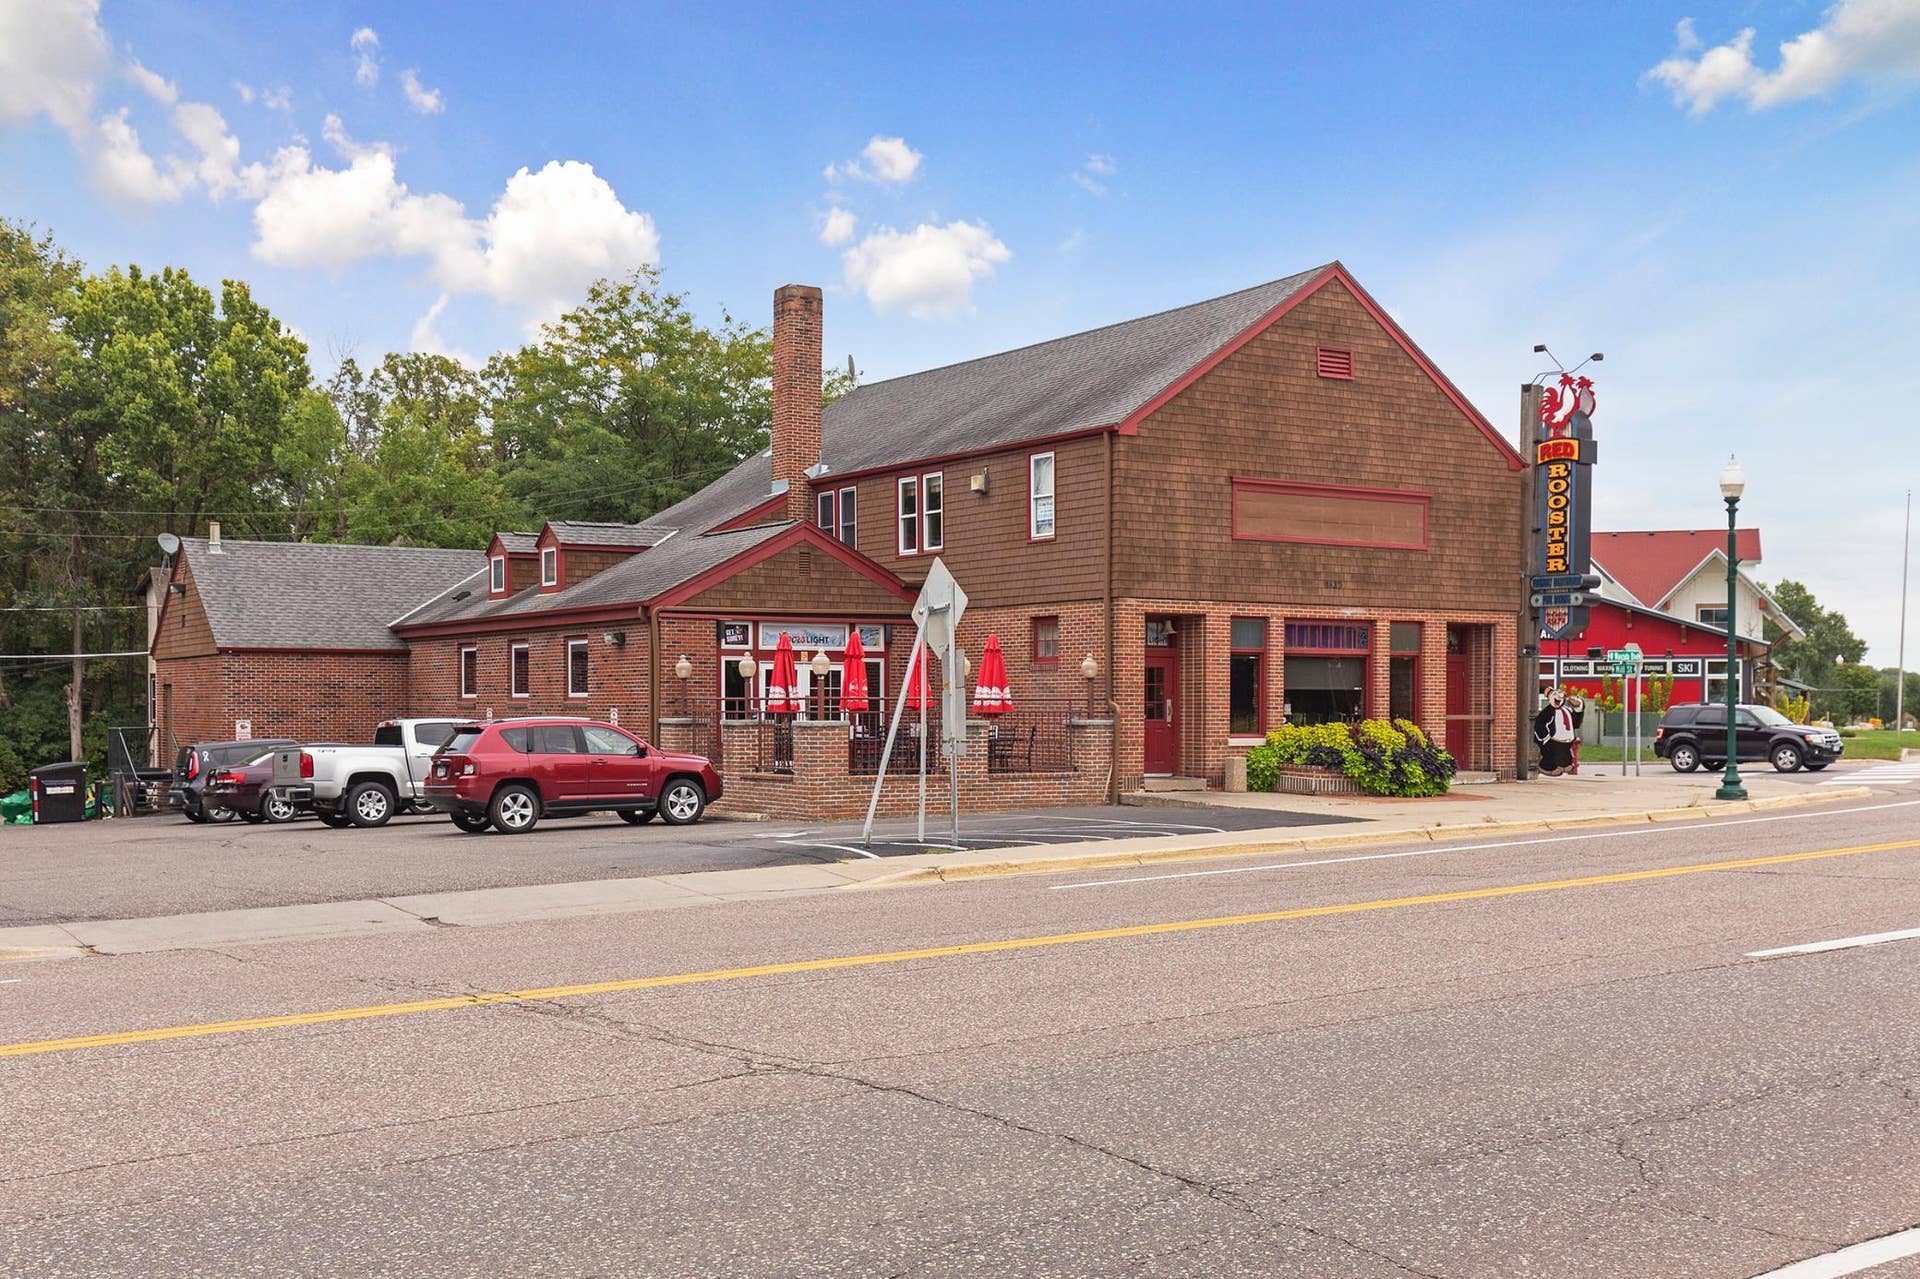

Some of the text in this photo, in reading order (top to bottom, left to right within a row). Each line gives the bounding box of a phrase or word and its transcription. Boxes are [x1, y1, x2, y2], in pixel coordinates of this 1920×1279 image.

[1540, 441, 1575, 461] RED
[1546, 463, 1569, 572] ROOSTER
[806, 636, 830, 644] LIGHT
[1677, 663, 1693, 672] SKI
